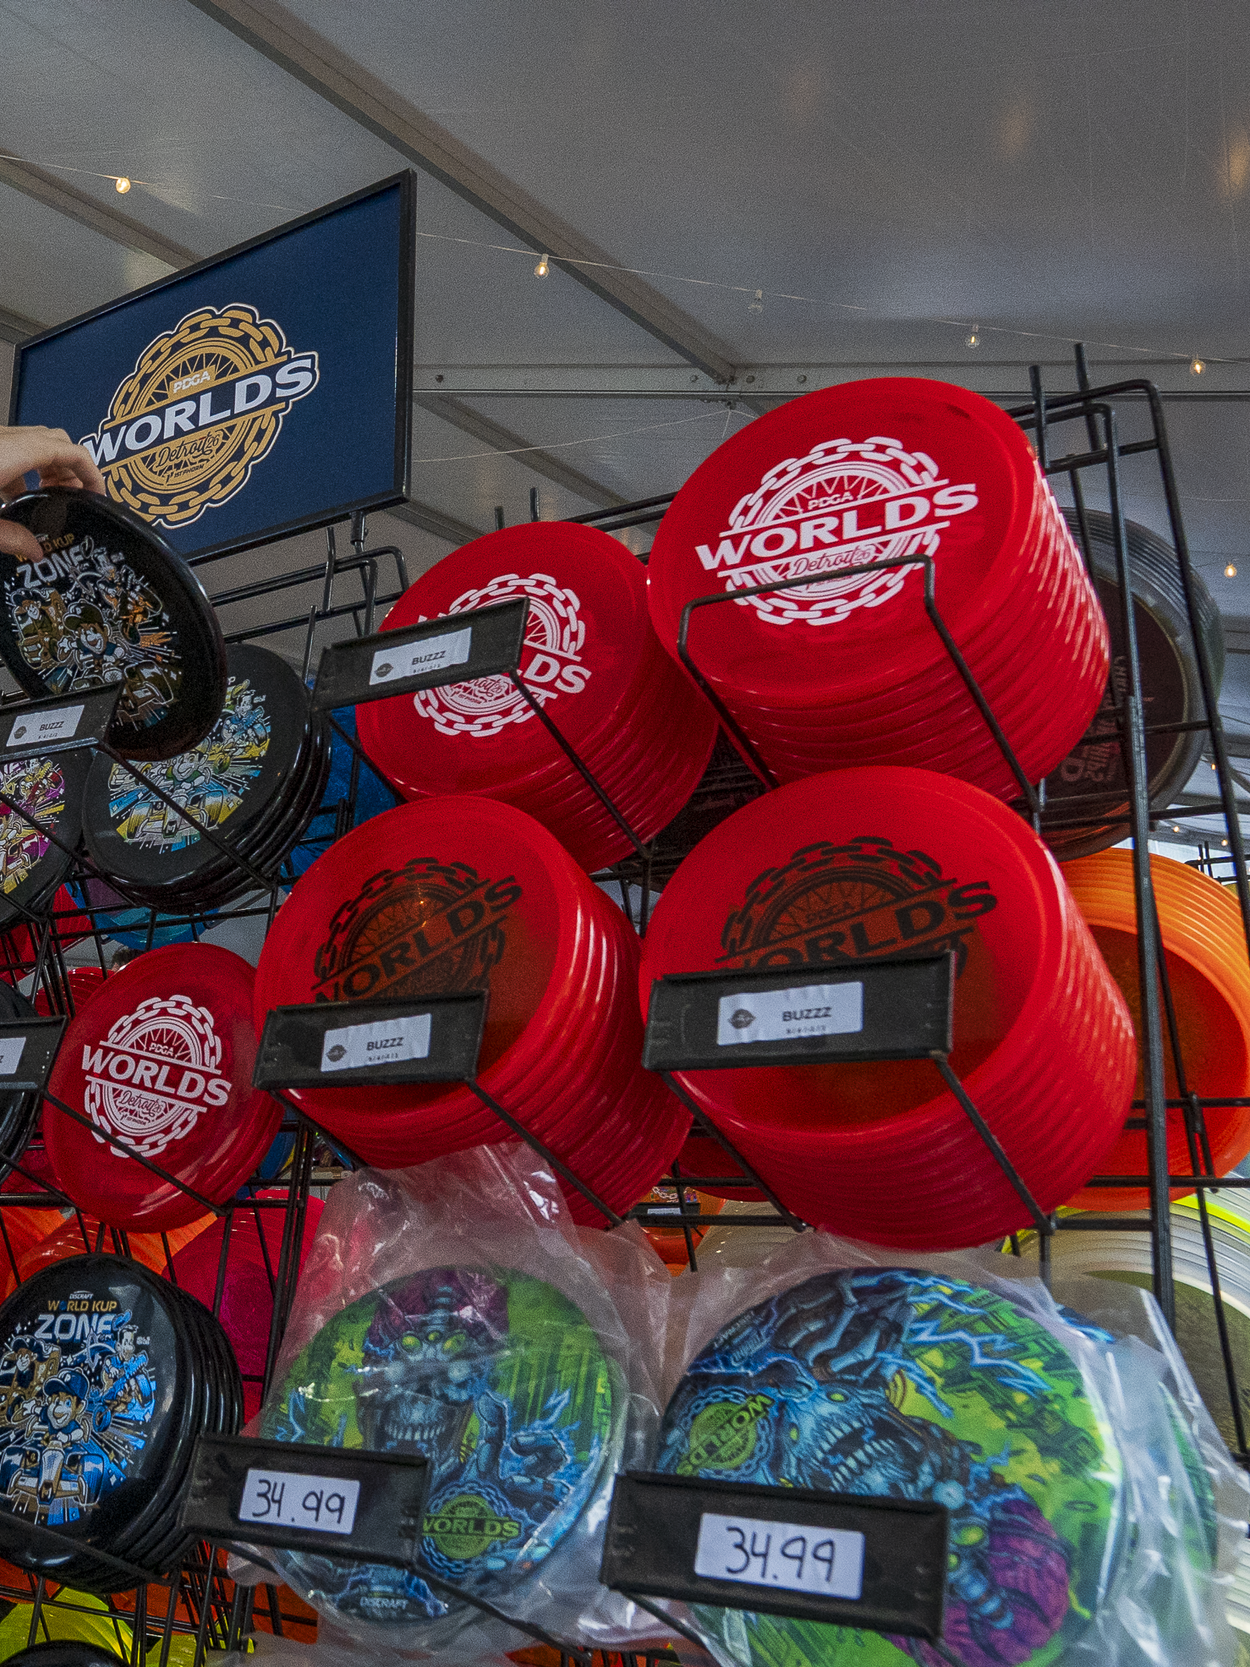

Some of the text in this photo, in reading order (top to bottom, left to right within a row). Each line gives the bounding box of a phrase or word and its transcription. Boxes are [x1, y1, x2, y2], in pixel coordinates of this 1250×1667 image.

[173, 370, 211, 394] PDGA
[83, 358, 313, 467] WORLDS
[807, 491, 854, 510] PDGA
[695, 483, 979, 571] WORLDS
[16, 545, 85, 589] ZONE
[792, 545, 860, 577] Detroit
[412, 650, 446, 666] BUZZZ
[39, 721, 65, 732] BUZZZ
[782, 1006, 832, 1021] BUZZZ
[149, 1042, 174, 1057] PDGA
[366, 1037, 404, 1051] BUZZZ
[81, 1044, 232, 1106] WORLDS
[91, 1300, 118, 1312] KUP
[34, 1313, 116, 1341] ZONE
[251, 1479, 346, 1524] 34.99
[726, 1526, 835, 1583] 34.99
